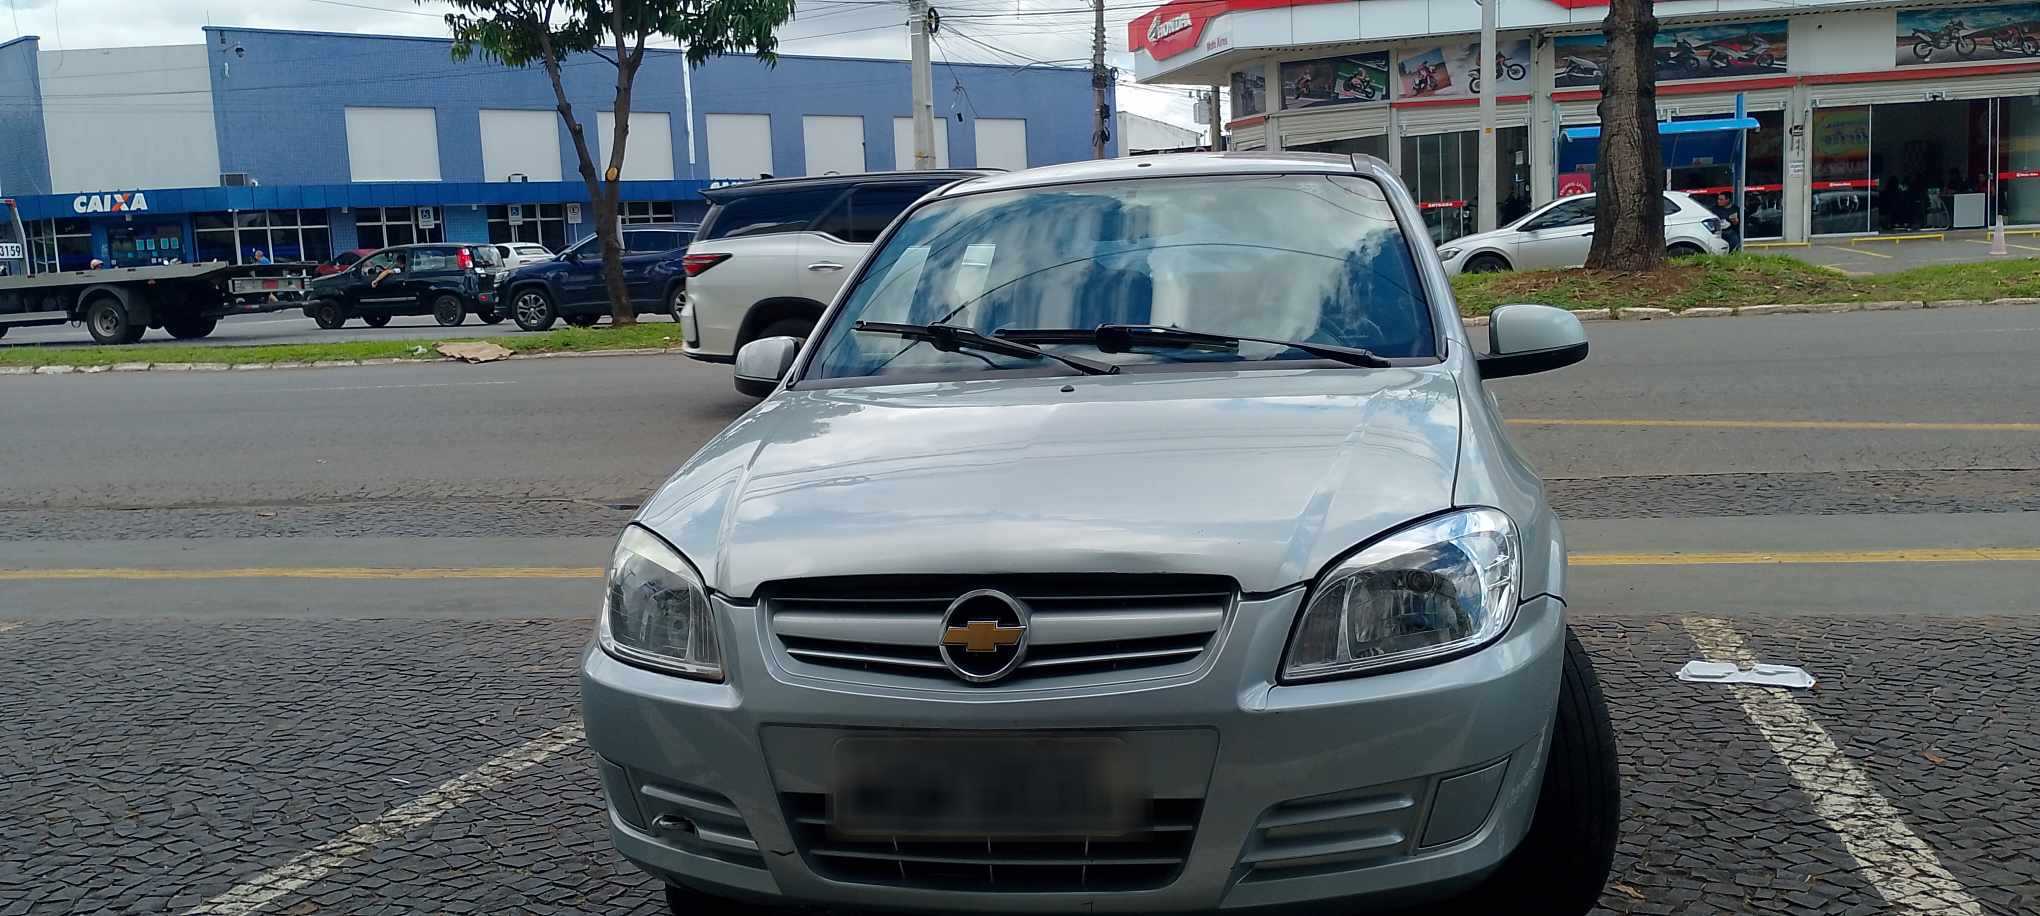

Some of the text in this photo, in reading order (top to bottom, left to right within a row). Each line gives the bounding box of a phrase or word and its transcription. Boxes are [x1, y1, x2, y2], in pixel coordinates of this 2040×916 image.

[1158, 12, 1192, 38] HONDA
[73, 192, 148, 213] CAIXA
[0, 245, 21, 257] 3159
